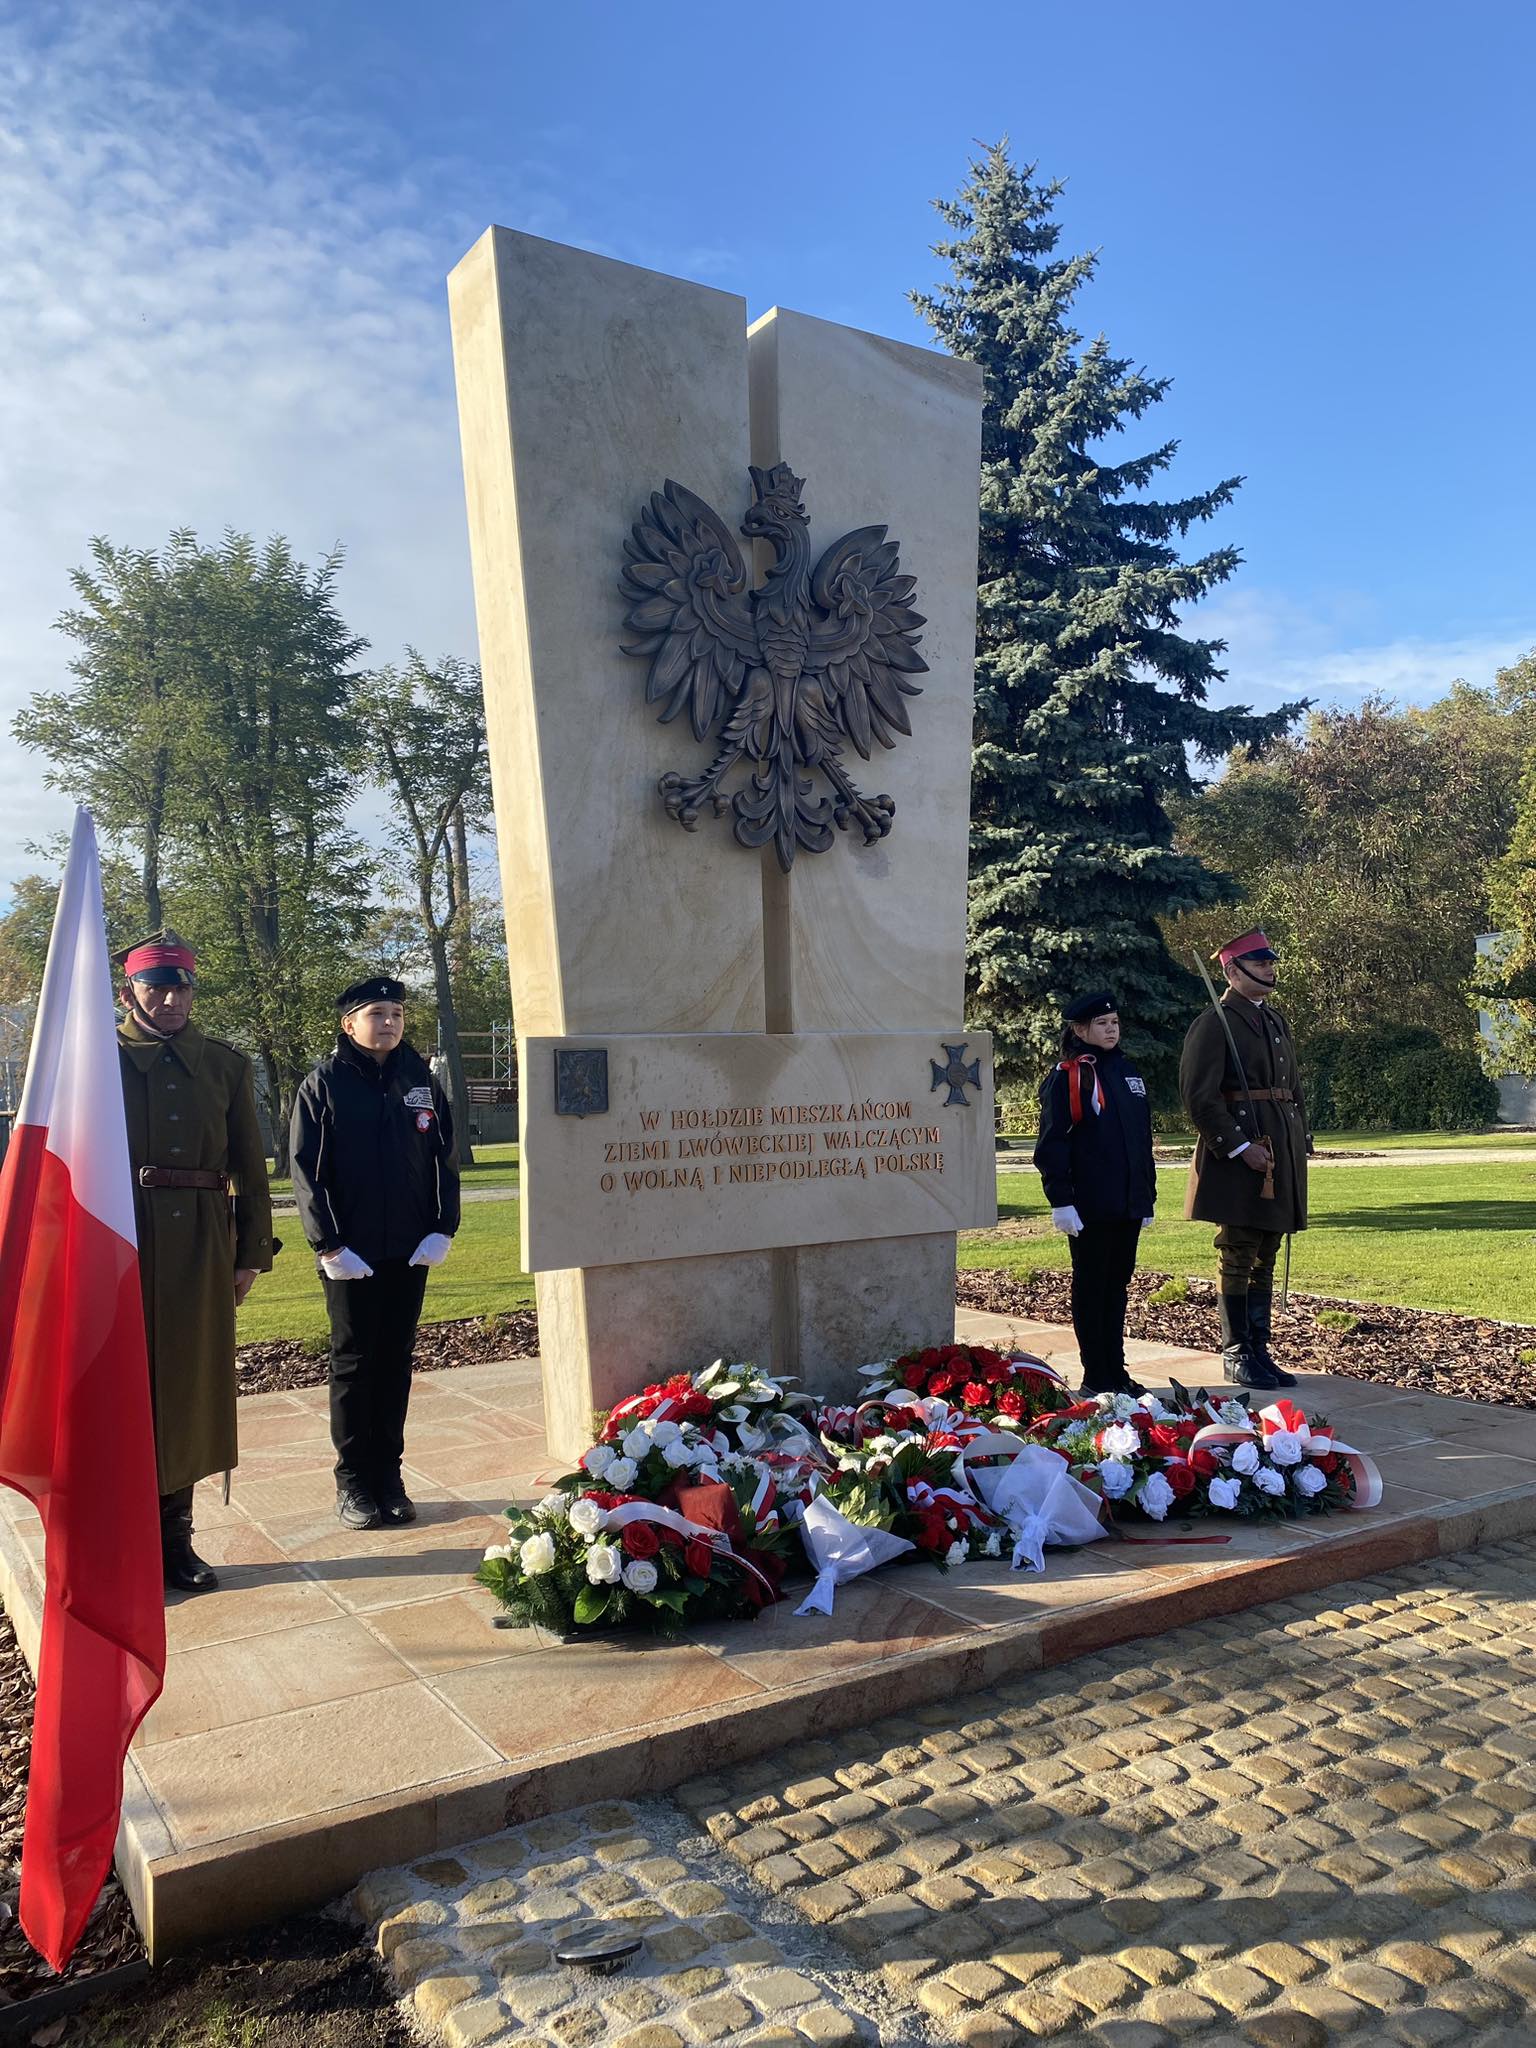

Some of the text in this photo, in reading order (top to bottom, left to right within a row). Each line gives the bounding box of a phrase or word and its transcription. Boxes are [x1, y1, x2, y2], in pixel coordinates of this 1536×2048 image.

[640, 1097, 912, 1131] W HOŁDZIE MIESZKAŃCOM
[604, 1127, 941, 1163] ZIEMI LWÓWECKIEJ WALCZĄCYM
[600, 1152, 944, 1193] O WOLNĄ I NIEPODLEGŁĄ POLSKĘ
